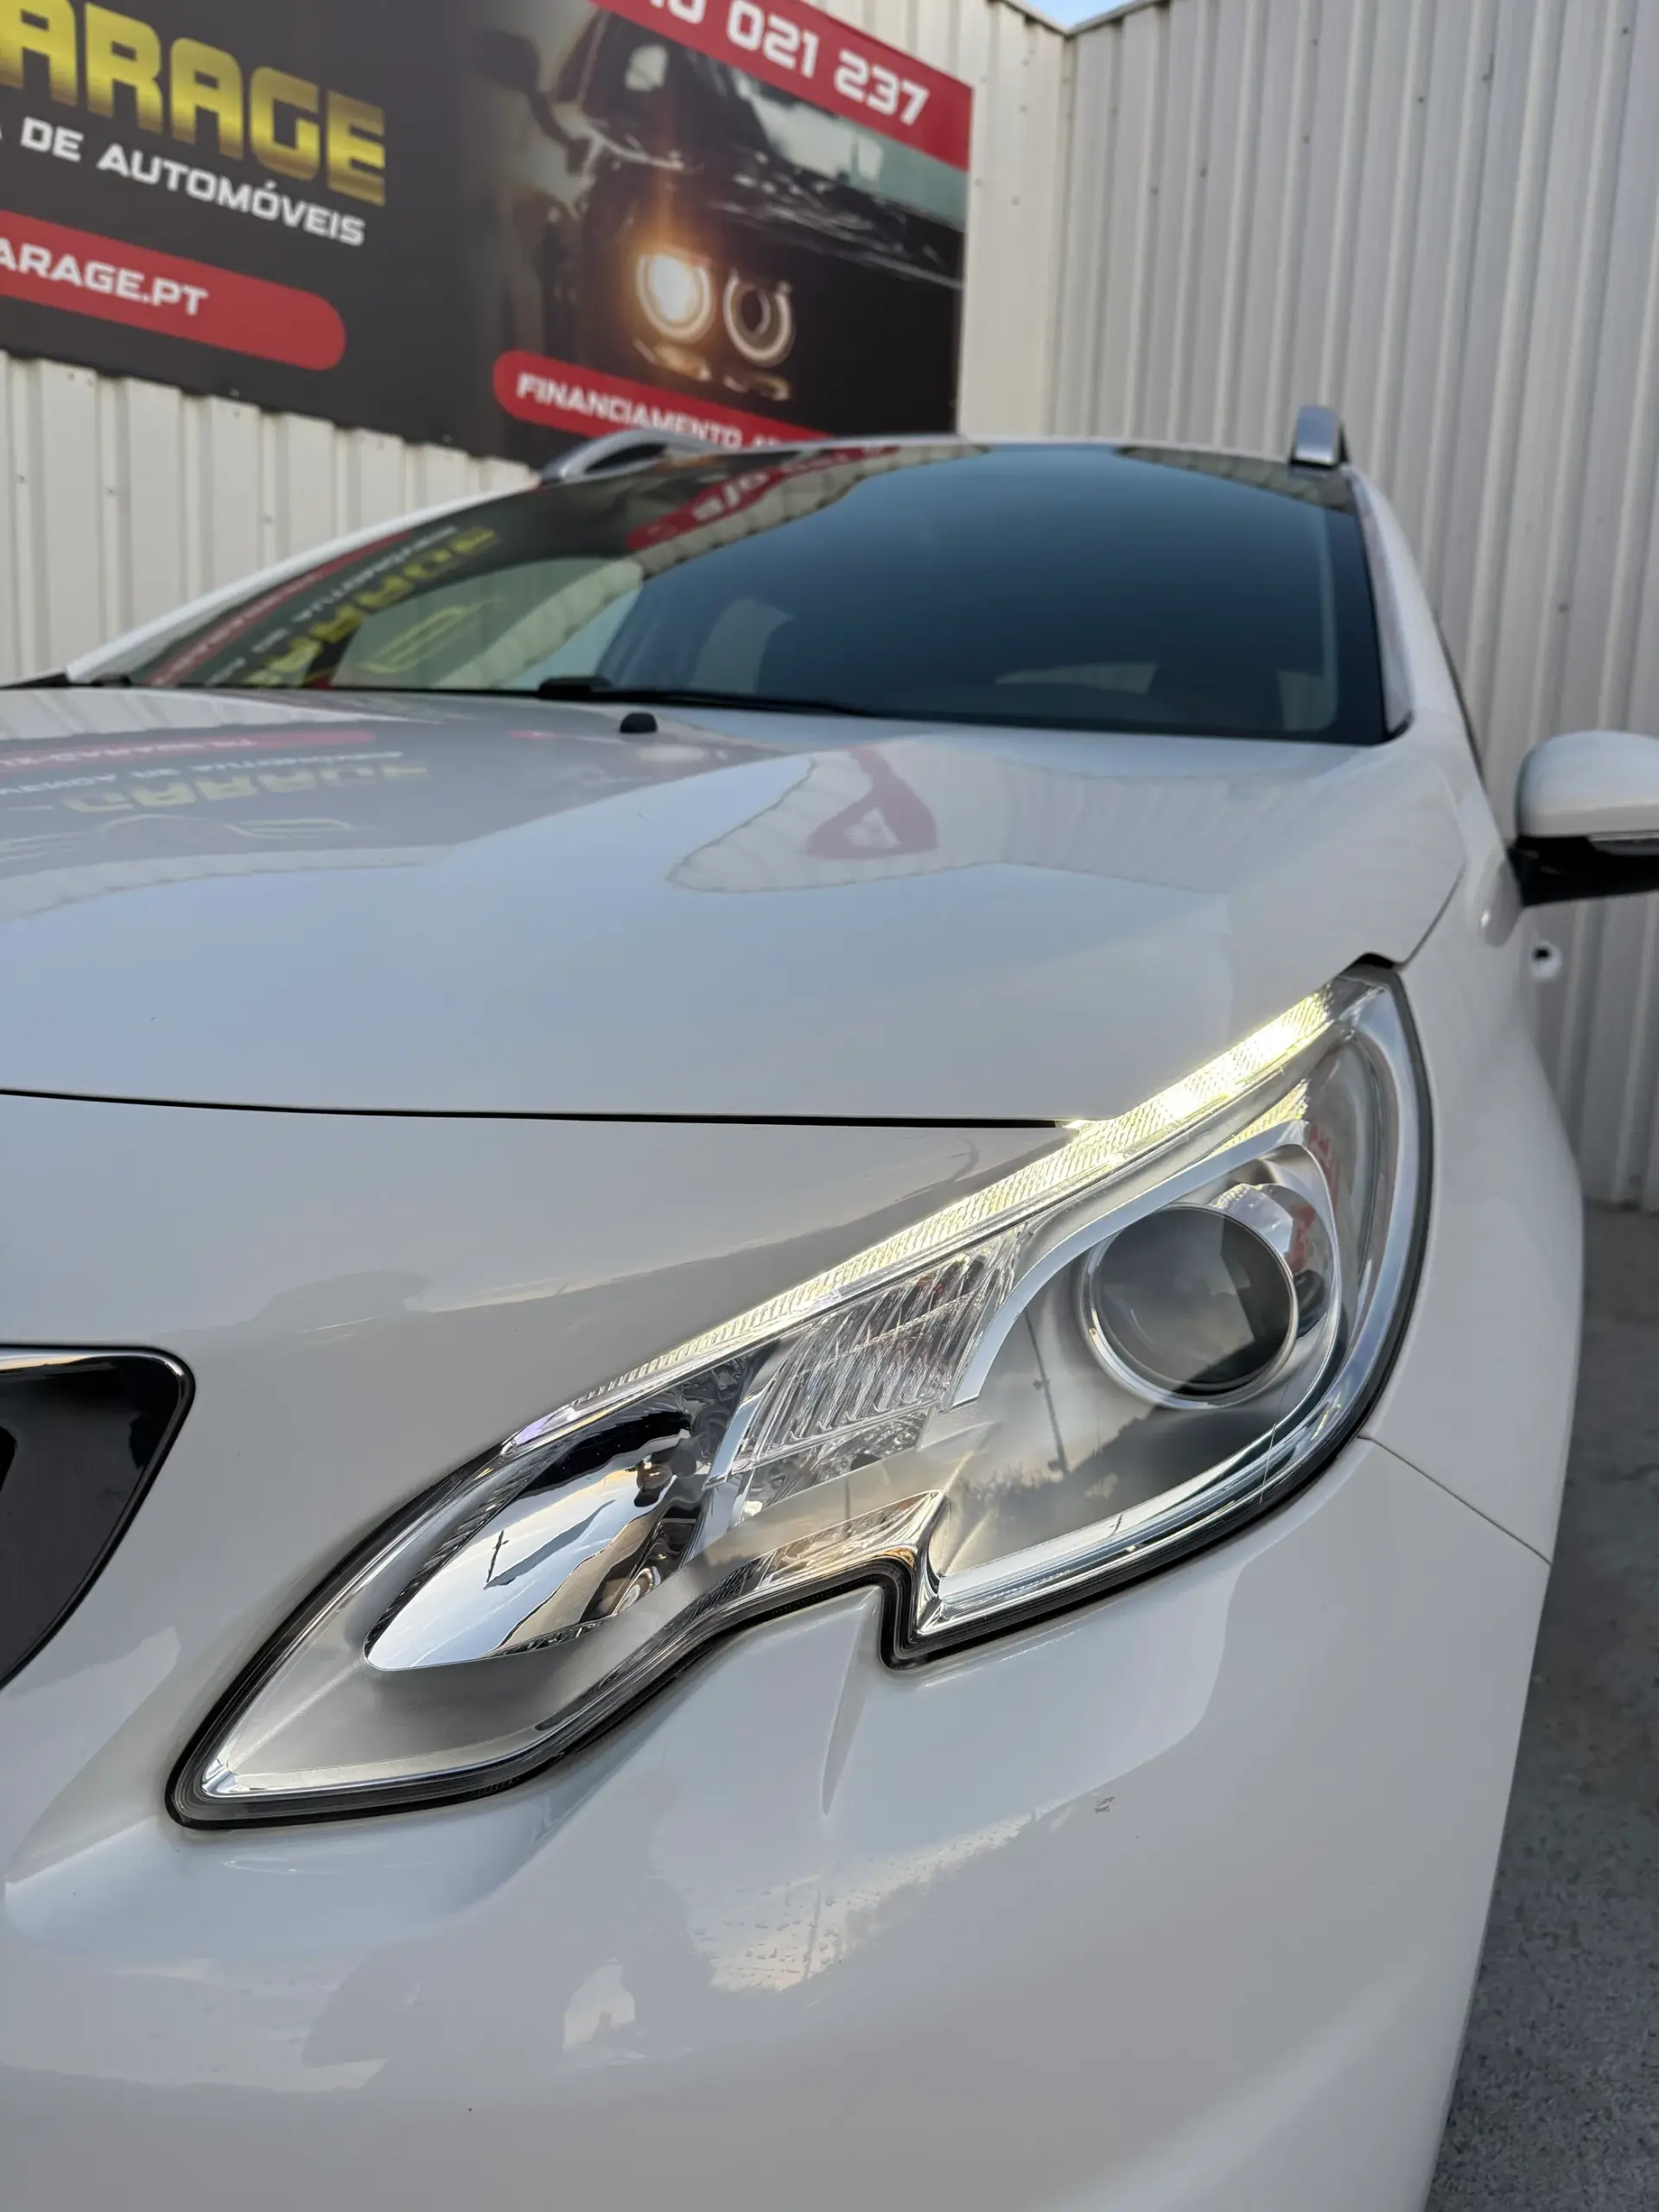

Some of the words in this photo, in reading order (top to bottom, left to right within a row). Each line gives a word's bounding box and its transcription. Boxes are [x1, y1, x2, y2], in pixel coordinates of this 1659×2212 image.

[727, 0, 819, 79] 021
[834, 49, 931, 126] 237
[20, 116, 85, 162] DE
[96, 143, 365, 247] AUTOMÓVEIS
[516, 372, 743, 450] FINANCIAMENTO
